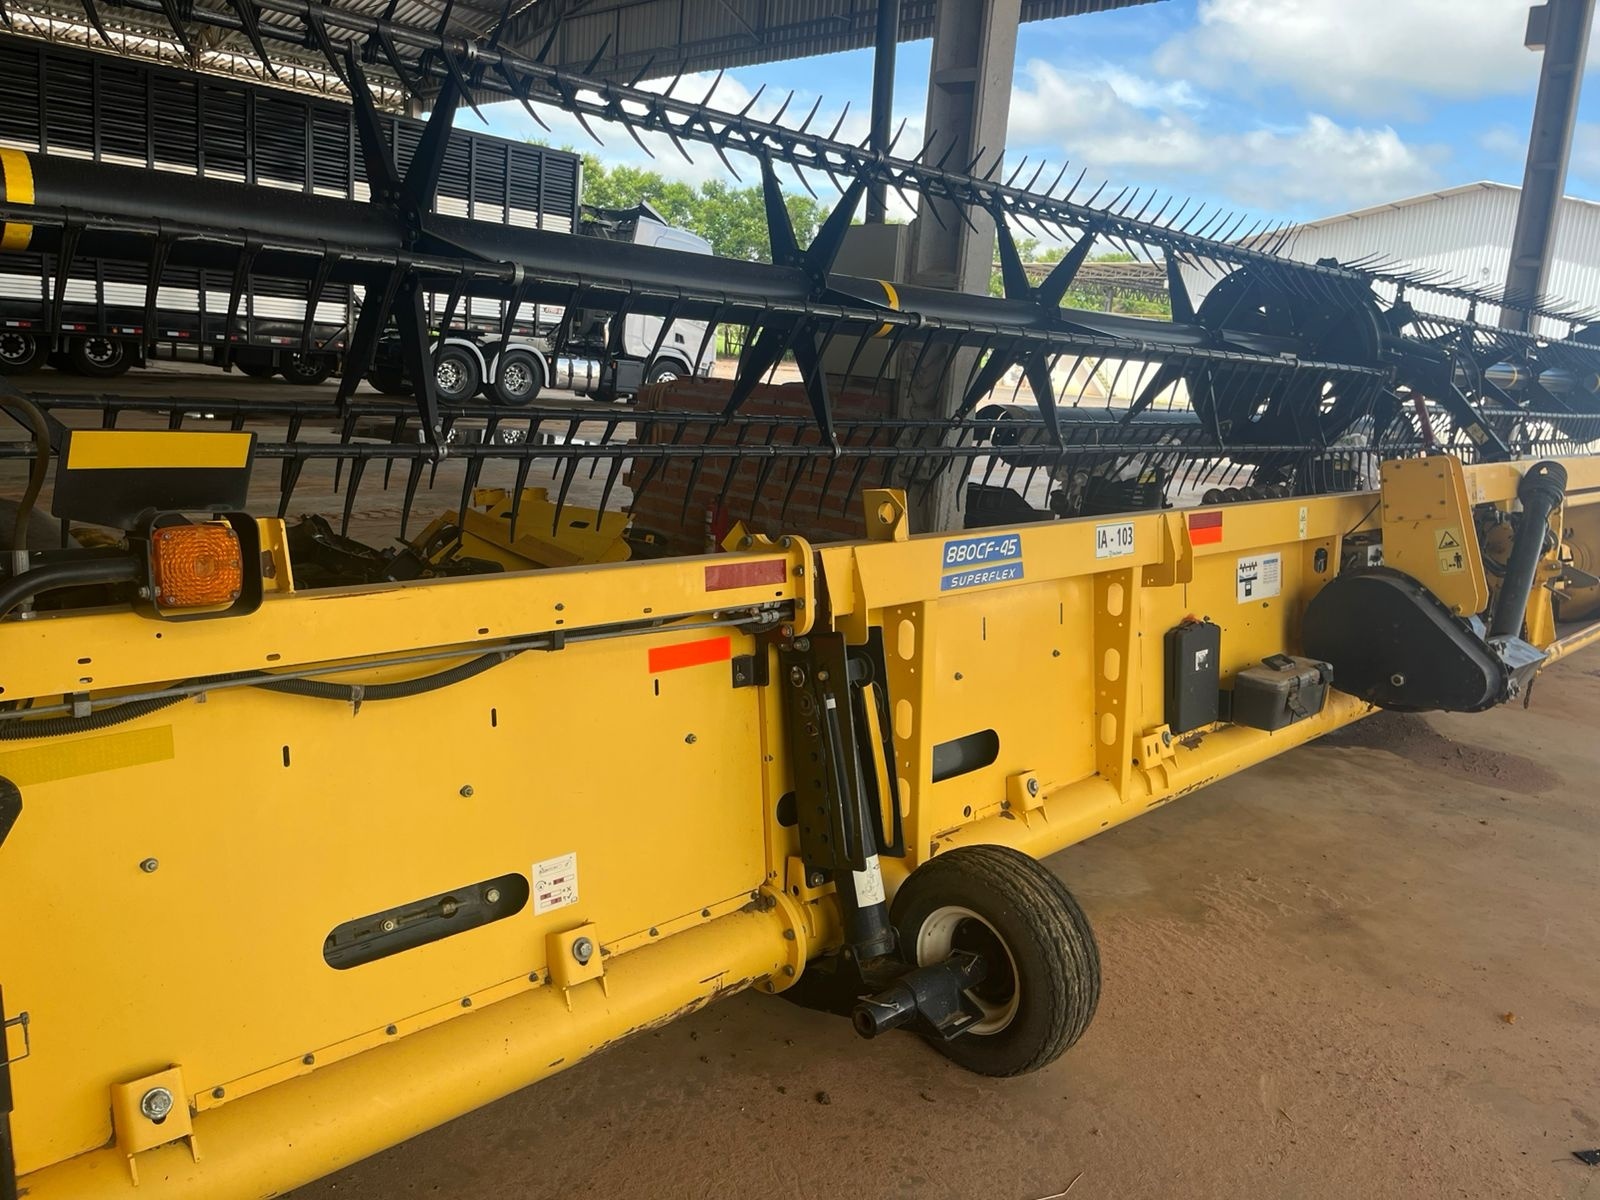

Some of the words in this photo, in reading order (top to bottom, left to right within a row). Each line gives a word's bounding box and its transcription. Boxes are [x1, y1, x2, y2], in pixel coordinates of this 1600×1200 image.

[1098, 530, 1108, 549] IA
[1117, 526, 1133, 546] 103
[946, 538, 1018, 563] 880CF-45
[950, 567, 1017, 588] SUPERFLEX
